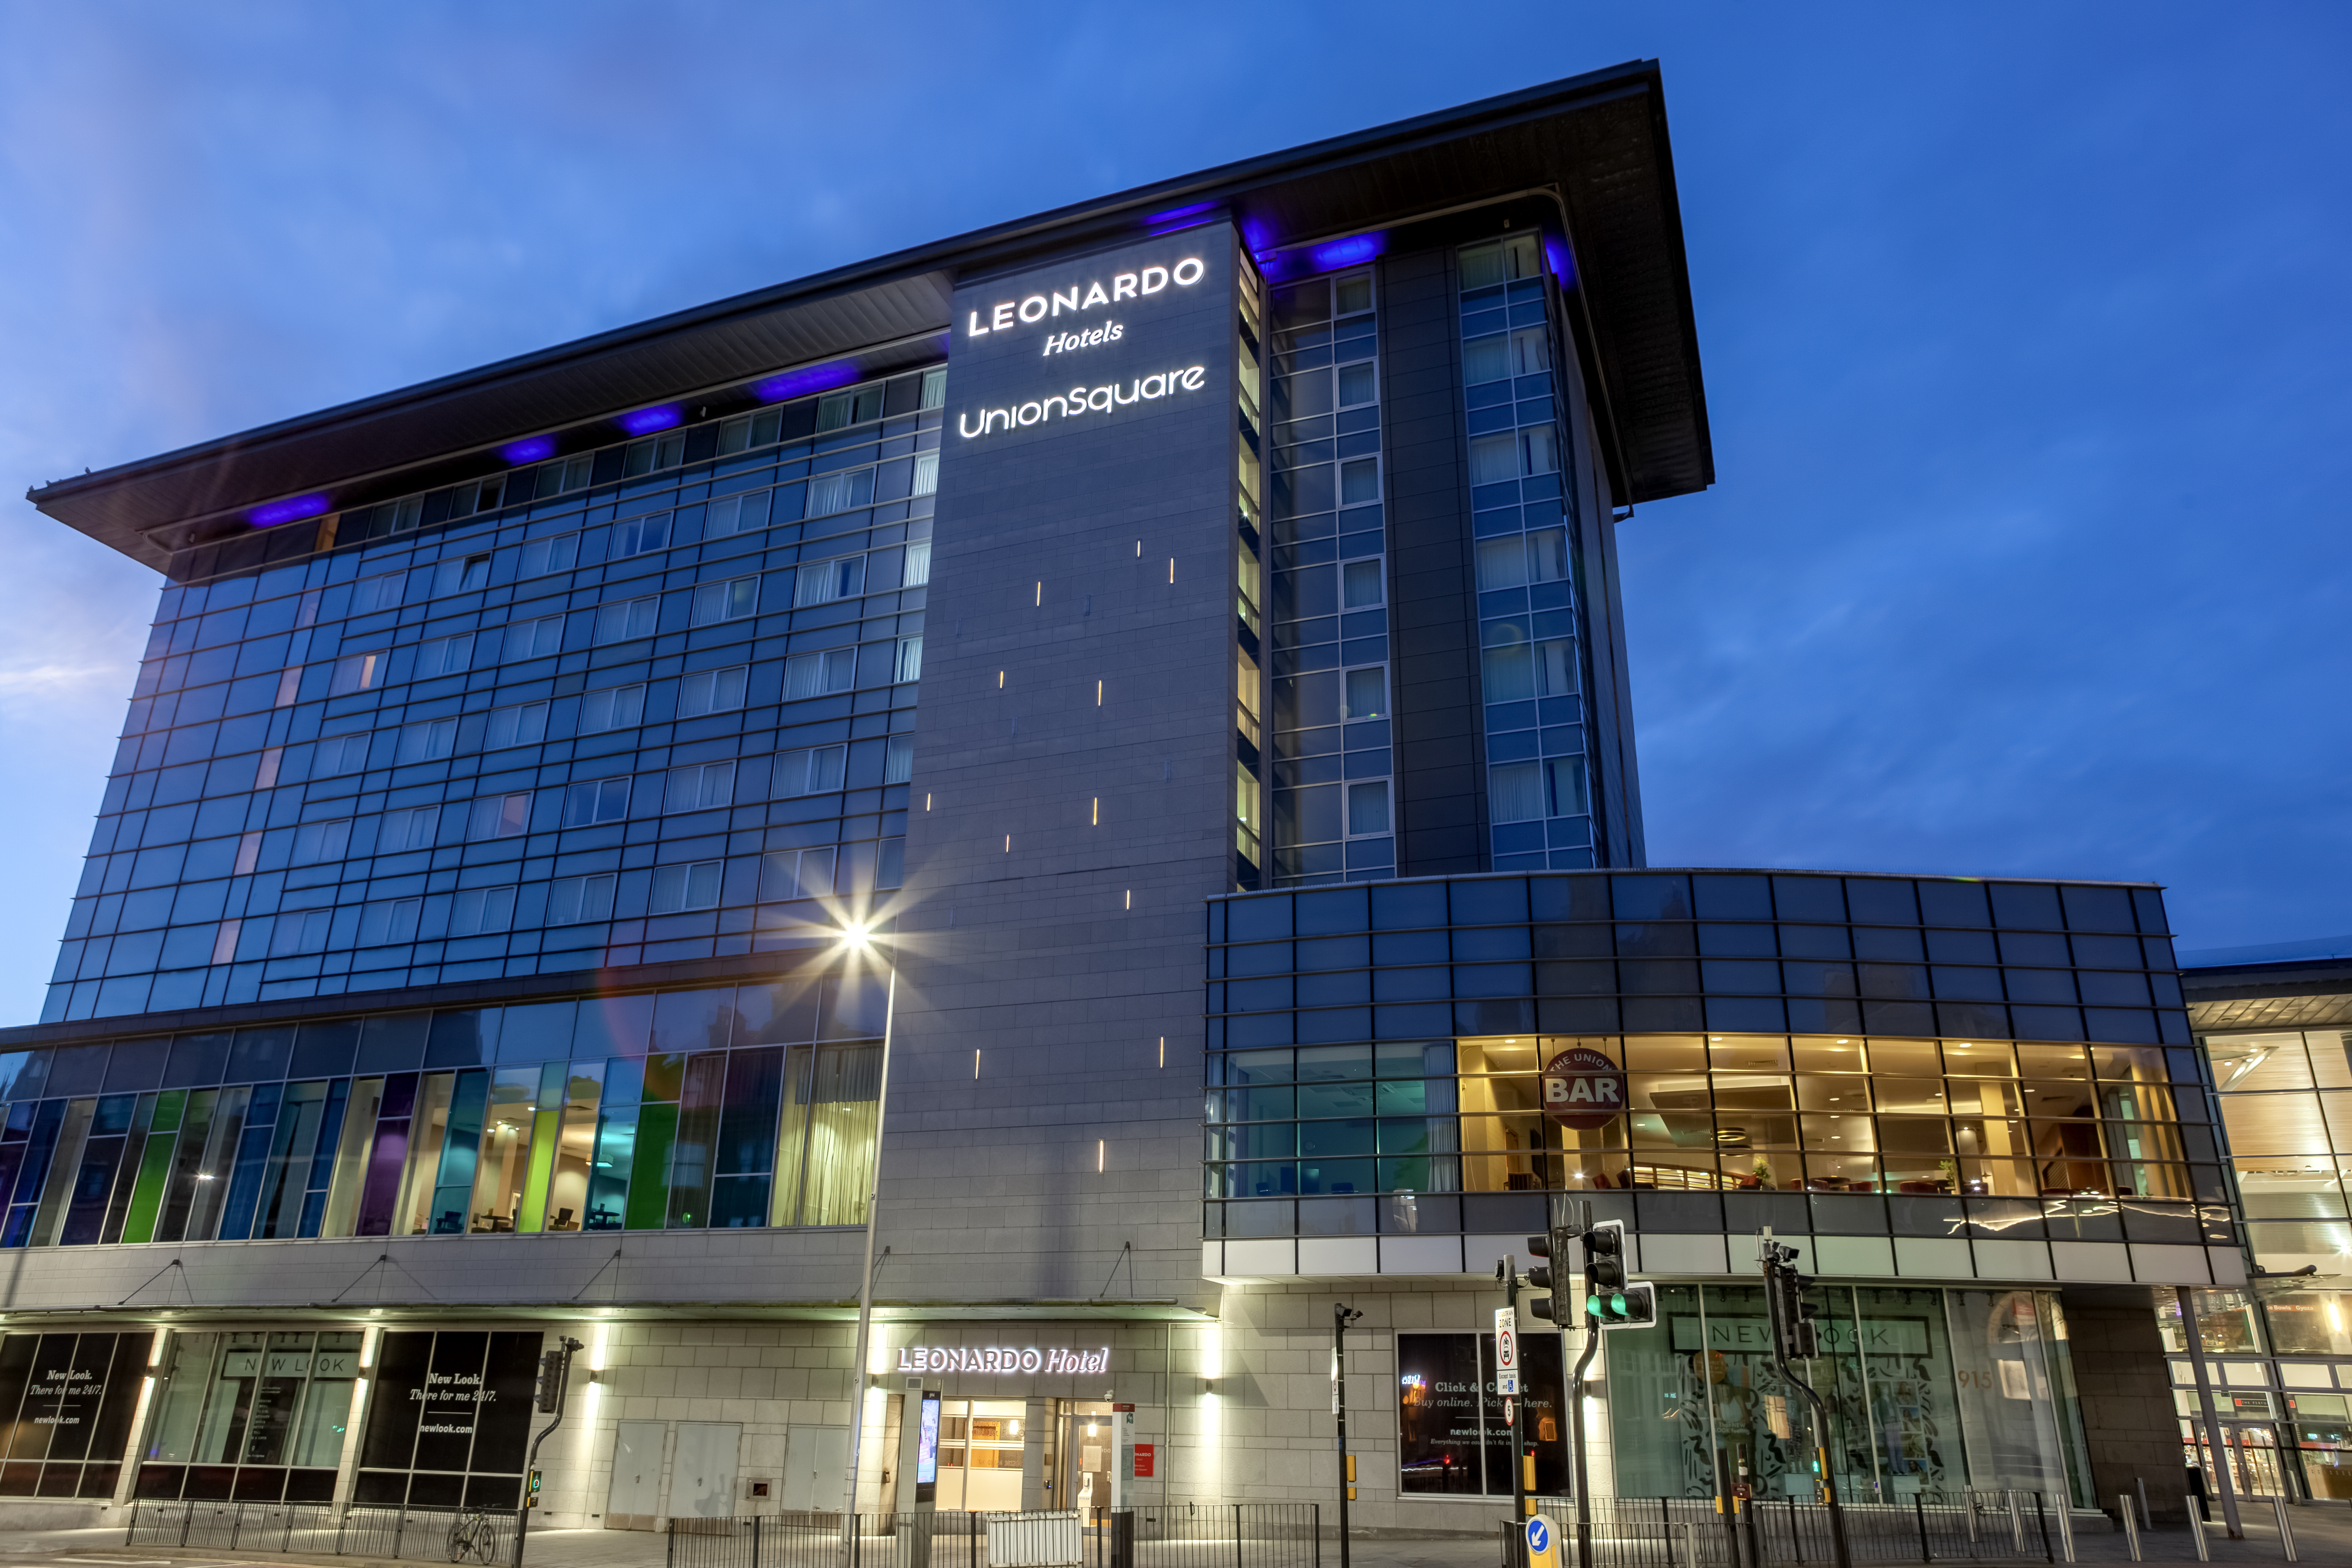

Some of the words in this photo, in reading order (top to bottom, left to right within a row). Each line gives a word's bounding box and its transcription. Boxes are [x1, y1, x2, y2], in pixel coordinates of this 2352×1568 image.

[969, 257, 1204, 337] LEONARDO
[1043, 320, 1124, 357] Hotels
[1550, 1056, 1571, 1071] THE
[1574, 1053, 1612, 1071] UNION
[1545, 1078, 1620, 1103] BAR
[1499, 1317, 1512, 1327] ZONE
[1823, 1327, 1889, 1345] OOK
[245, 1358, 286, 1371] NW
[897, 1348, 1041, 1372] LEONARDO
[1044, 1348, 1109, 1372] Hotel
[47, 1370, 67, 1380] New
[69, 1370, 92, 1380] Look.
[428, 1373, 452, 1384] New
[453, 1373, 482, 1384] Look.
[1958, 1370, 1993, 1389] 915
[30, 1385, 53, 1395] There
[82, 1384, 102, 1395] 24/7.
[1435, 1382, 1467, 1392] Click
[1469, 1382, 1479, 1392] &
[439, 1389, 454, 1401] for
[1414, 1396, 1434, 1409] Buy
[1437, 1397, 1473, 1407] online.
[1477, 1397, 1504, 1407] Pick
[1524, 1398, 1552, 1408] here.
[1507, 1405, 1511, 1417] 5
[420, 1423, 473, 1433] newlook.com
[972, 1428, 985, 1436] ON
[988, 1428, 999, 1437] 1st
